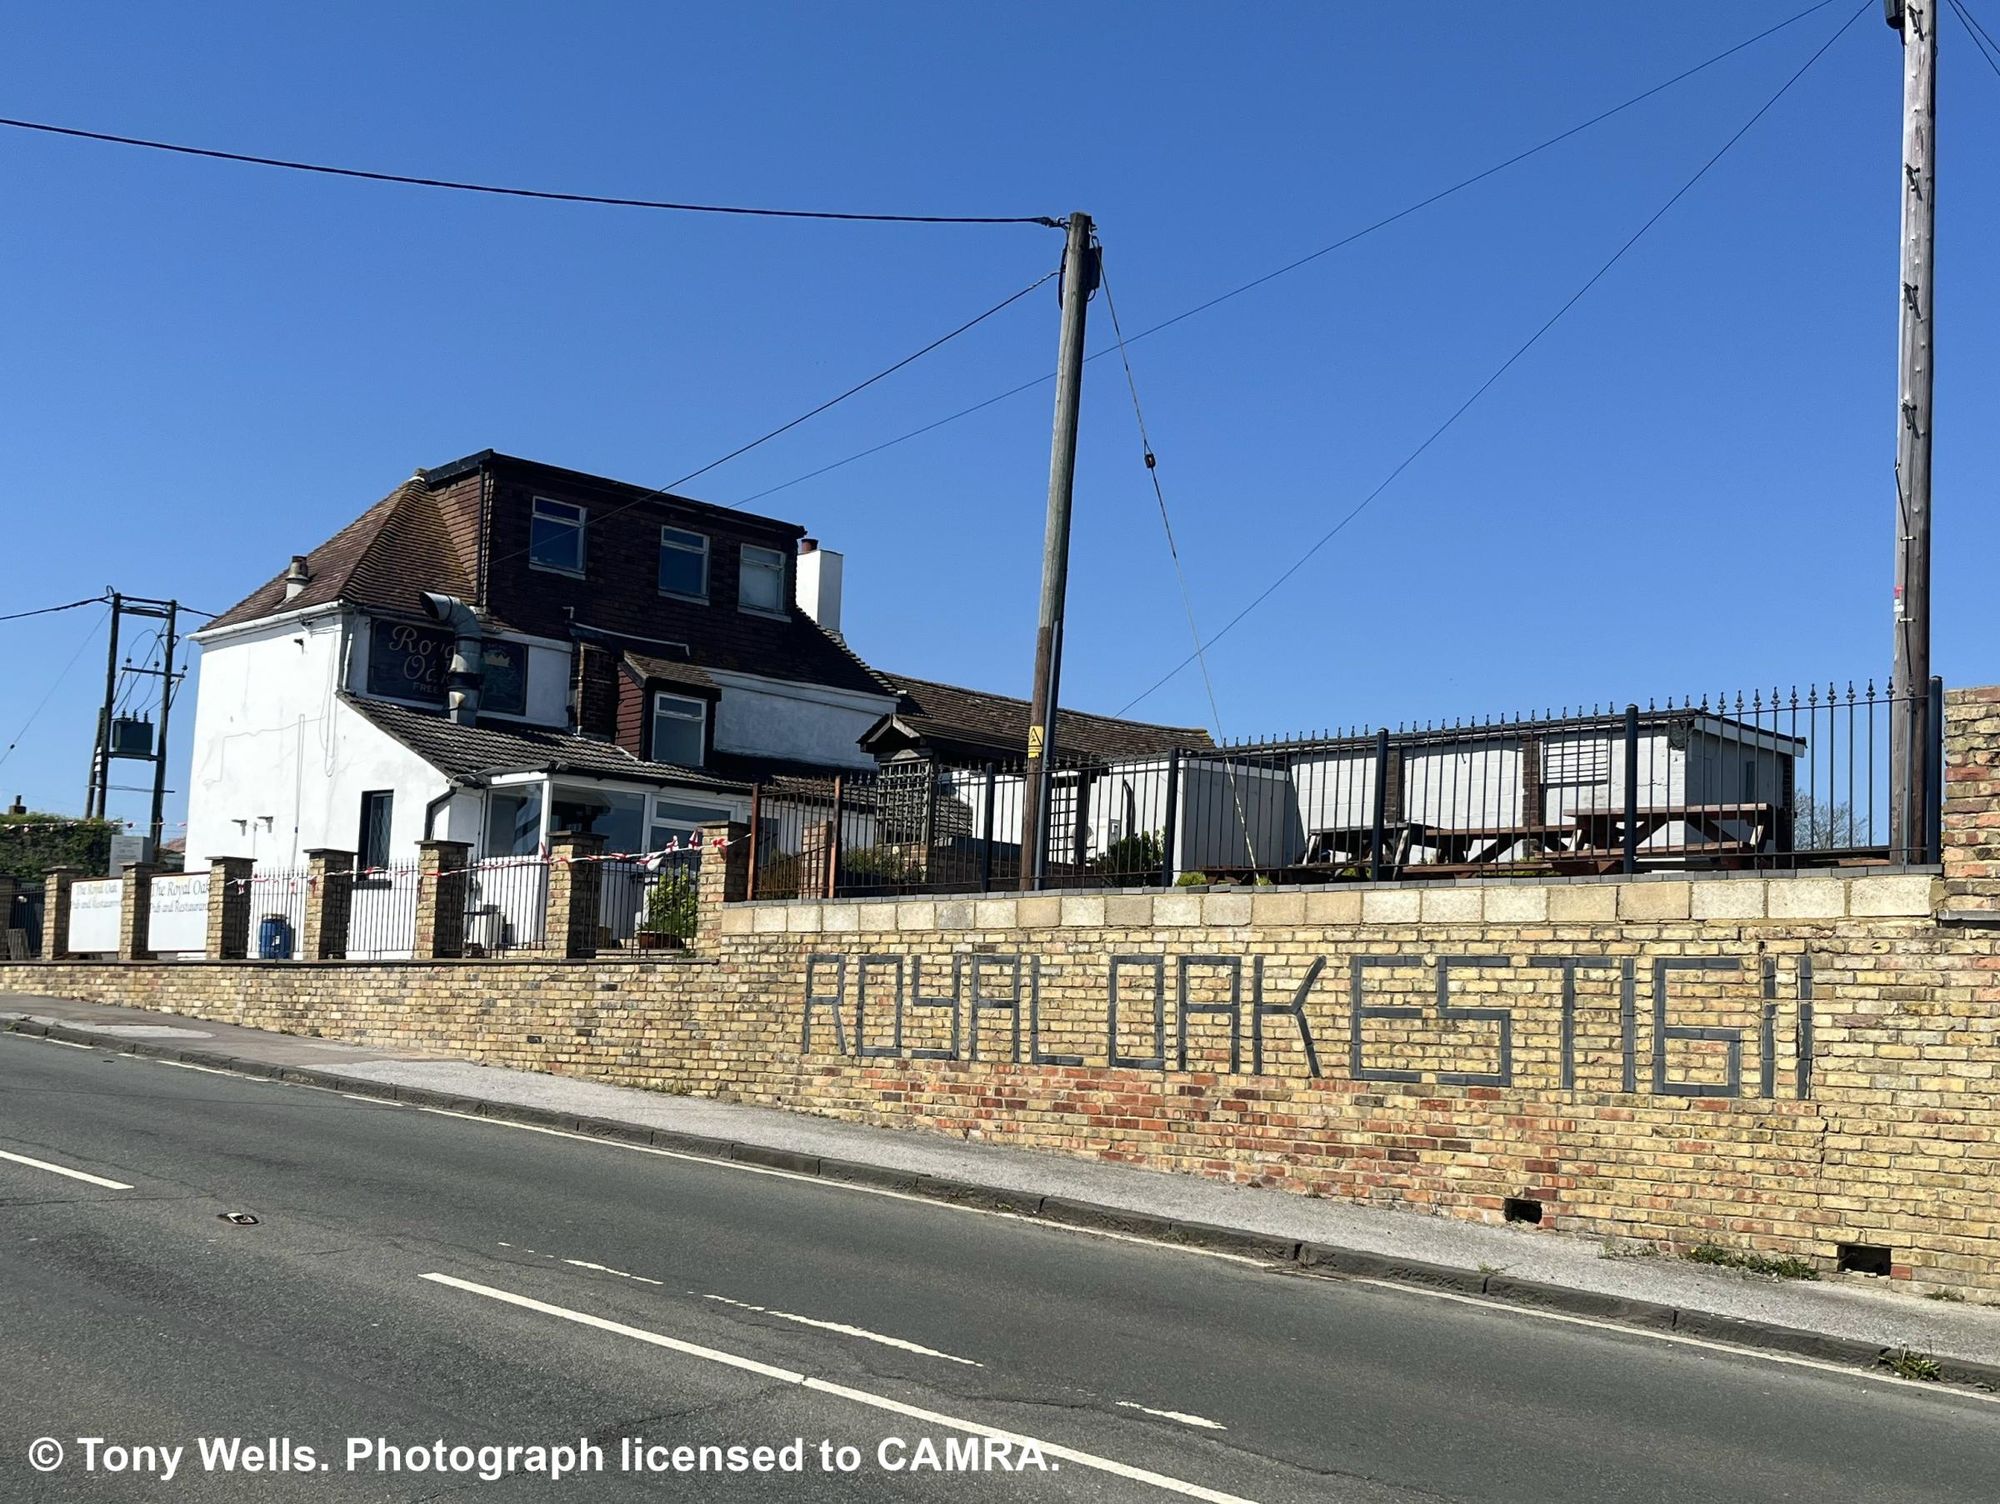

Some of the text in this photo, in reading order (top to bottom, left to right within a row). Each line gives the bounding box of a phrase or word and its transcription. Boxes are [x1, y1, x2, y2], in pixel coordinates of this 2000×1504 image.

[388, 625, 455, 661] Roa
[412, 681, 439, 695] FREE
[151, 880, 164, 897] The
[167, 878, 191, 902] Royal
[162, 900, 173, 913] and
[175, 899, 207, 913] Restauran
[802, 953, 1084, 1068] ROYAL
[1108, 954, 1326, 1077] OAK
[1351, 955, 1613, 1090] EST
